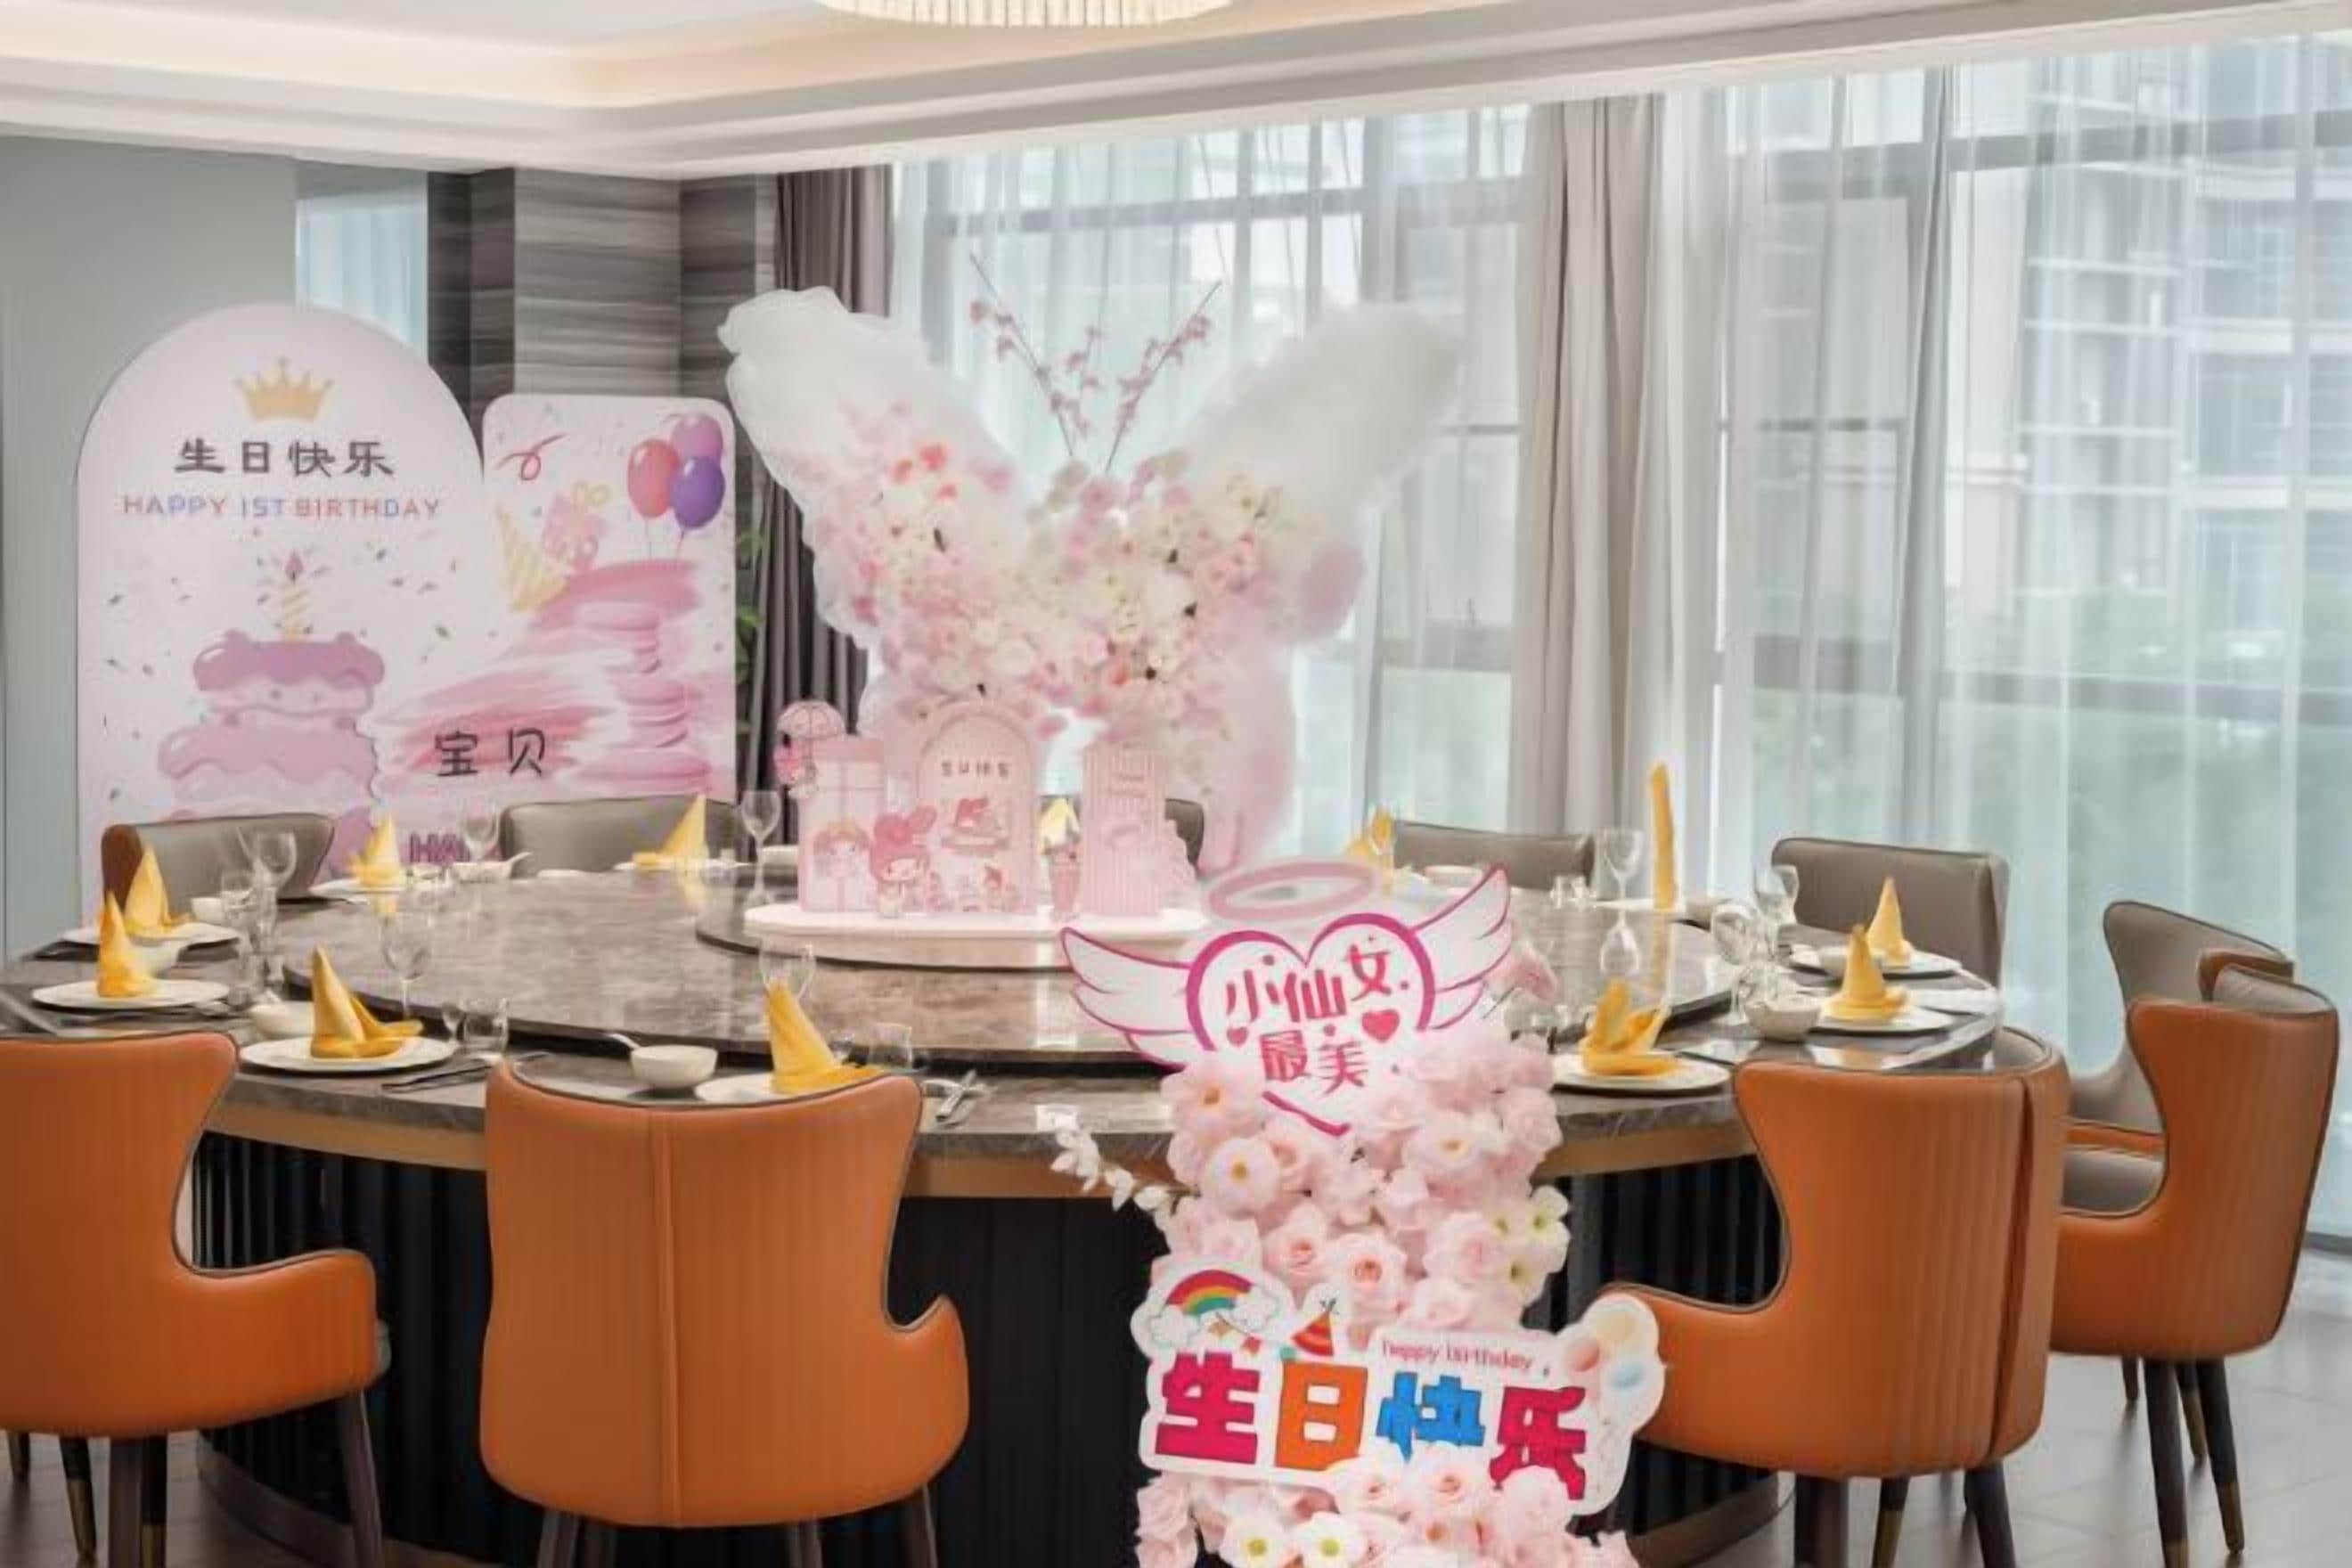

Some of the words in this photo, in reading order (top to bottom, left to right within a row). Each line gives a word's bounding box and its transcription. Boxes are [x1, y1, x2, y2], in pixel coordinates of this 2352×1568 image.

[174, 437, 394, 478] 生日快乐
[123, 495, 226, 515] HAPPY
[295, 497, 440, 520] BIRTHDAY
[435, 727, 545, 777] 宝贝
[1224, 943, 1393, 1023] 小仙女
[1260, 1029, 1369, 1096] 最美
[1155, 1352, 1588, 1501] 生日快乐
